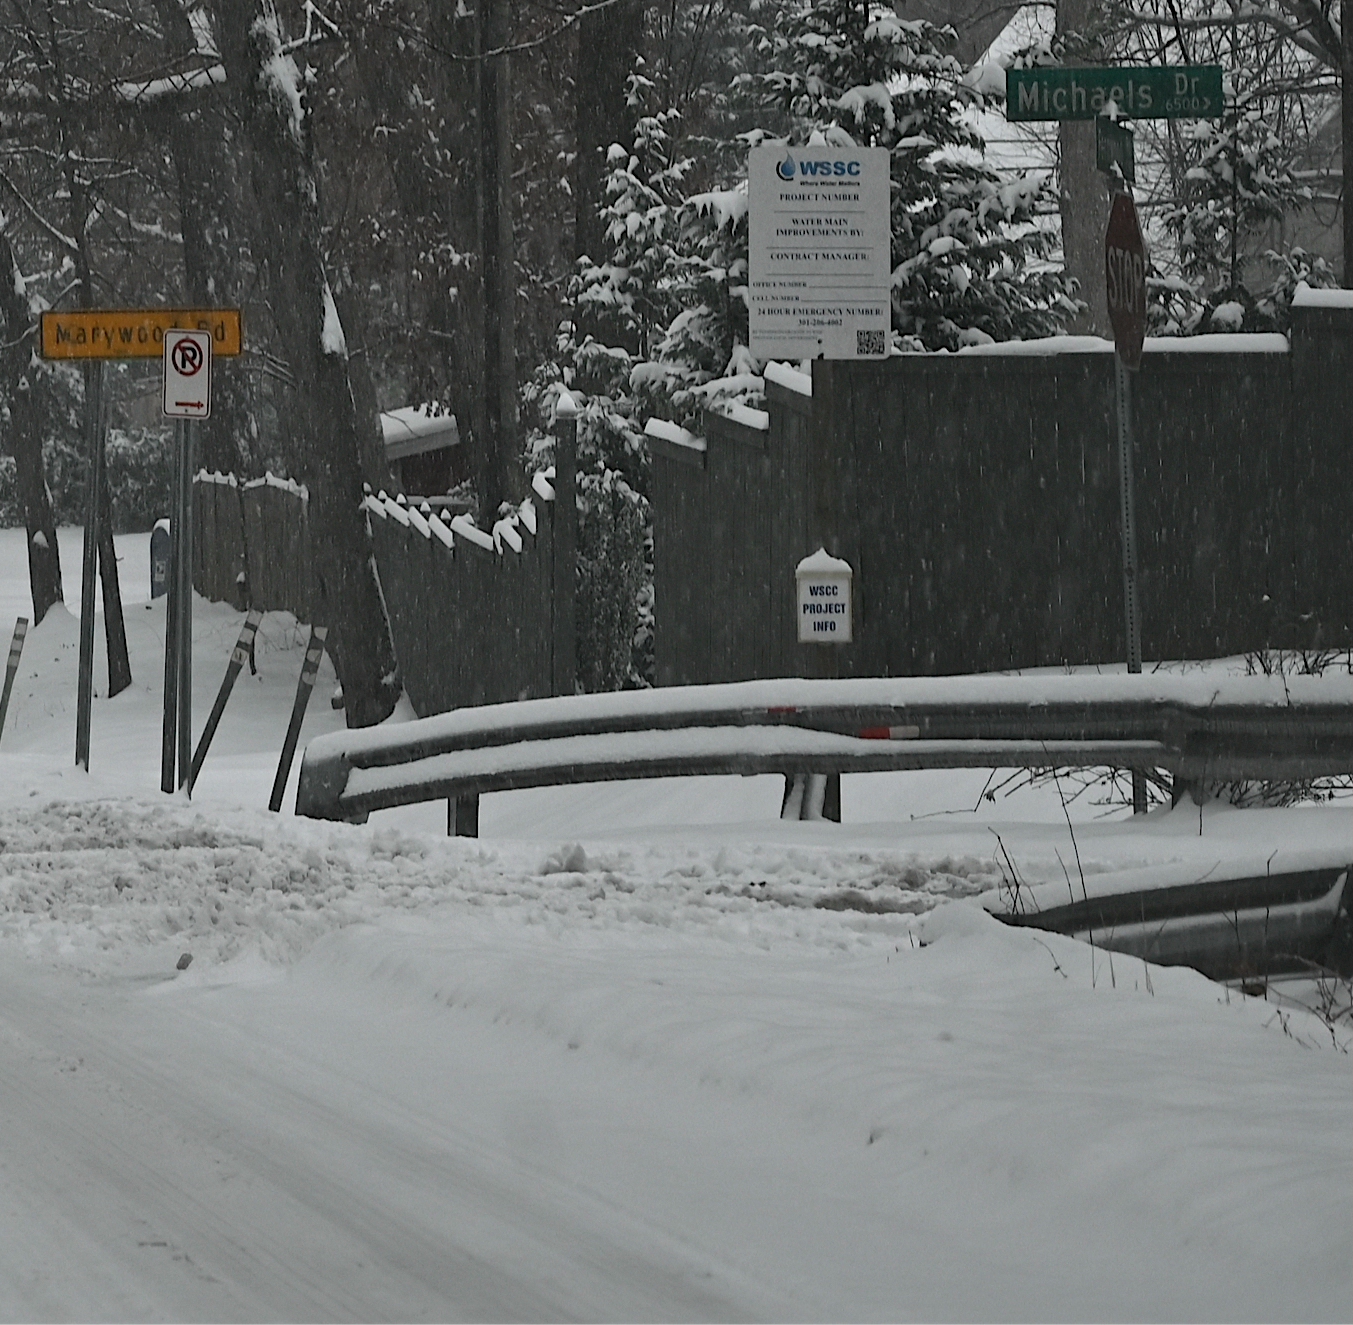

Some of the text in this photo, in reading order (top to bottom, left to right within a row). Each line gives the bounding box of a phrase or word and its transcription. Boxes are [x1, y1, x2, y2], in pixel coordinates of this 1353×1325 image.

[1017, 72, 1200, 113] Michaels Dr
[799, 161, 861, 176] WSSC
[779, 193, 860, 202] PROJECT NUMBER
[791, 218, 849, 226] WATER MAIN
[776, 228, 848, 237] IMPROVEMENTS
[770, 252, 819, 261] CONTRACT
[1106, 245, 1142, 314] STOP
[767, 307, 791, 316] HOUR
[792, 307, 843, 316] EMERGENCY
[55, 320, 179, 349] Marywoo
[809, 585, 838, 596] WSCC
[802, 603, 846, 614] PROJECT
[813, 620, 836, 632] INFO
